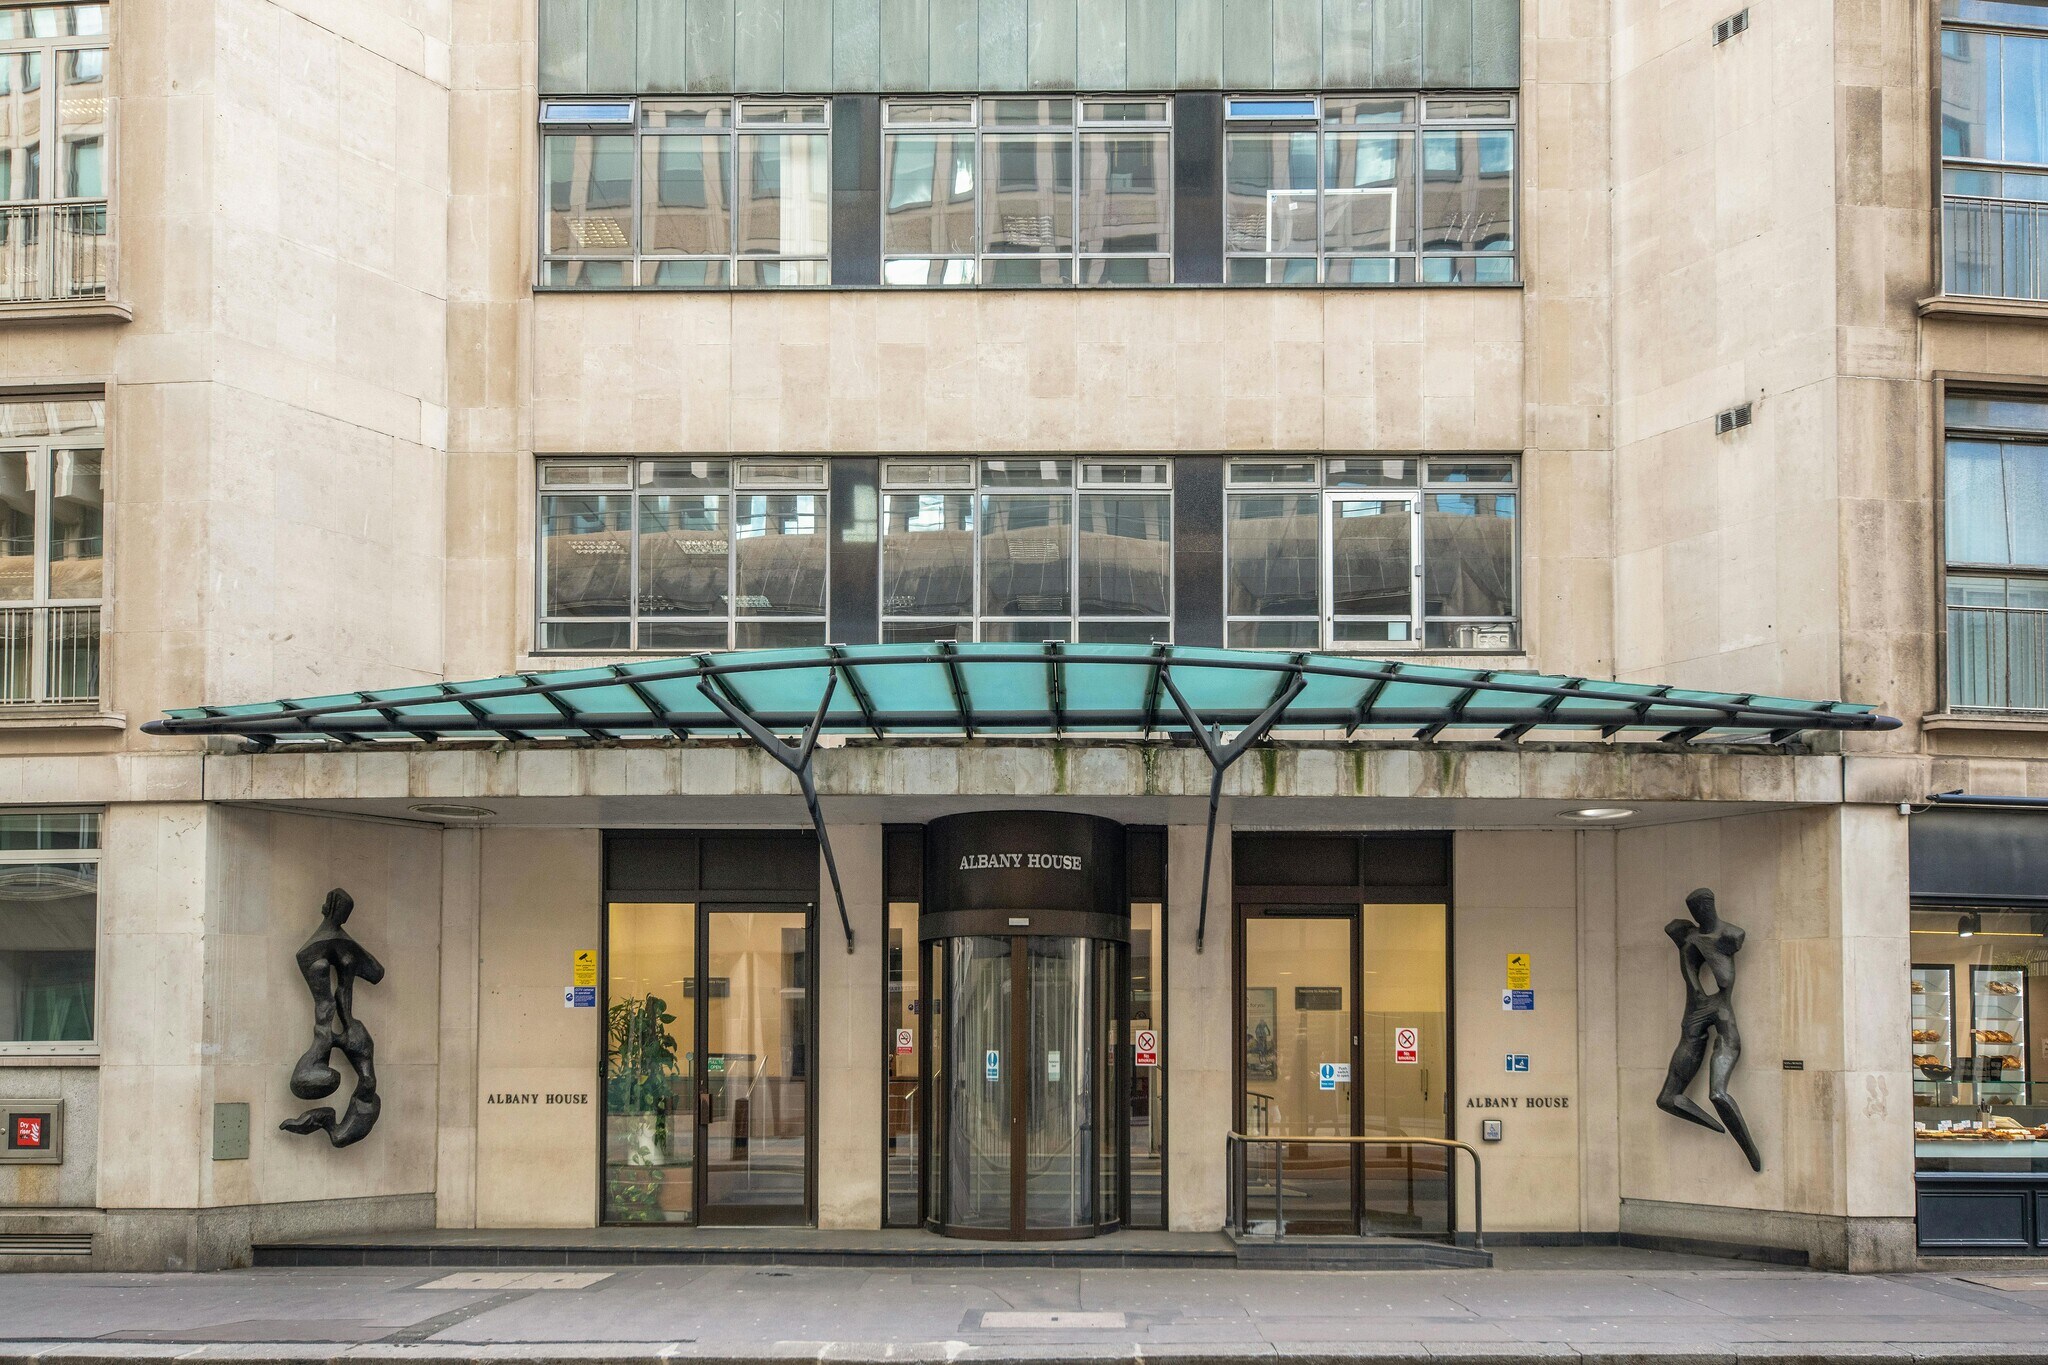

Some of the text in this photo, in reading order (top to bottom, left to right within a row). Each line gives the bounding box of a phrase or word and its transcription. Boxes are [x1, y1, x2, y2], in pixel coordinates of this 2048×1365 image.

[960, 853, 1082, 870] ALBANY HOUSE
[487, 1093, 588, 1104] ALBANY HOUSE
[1466, 1097, 1569, 1108] ALBANY HOUSE
